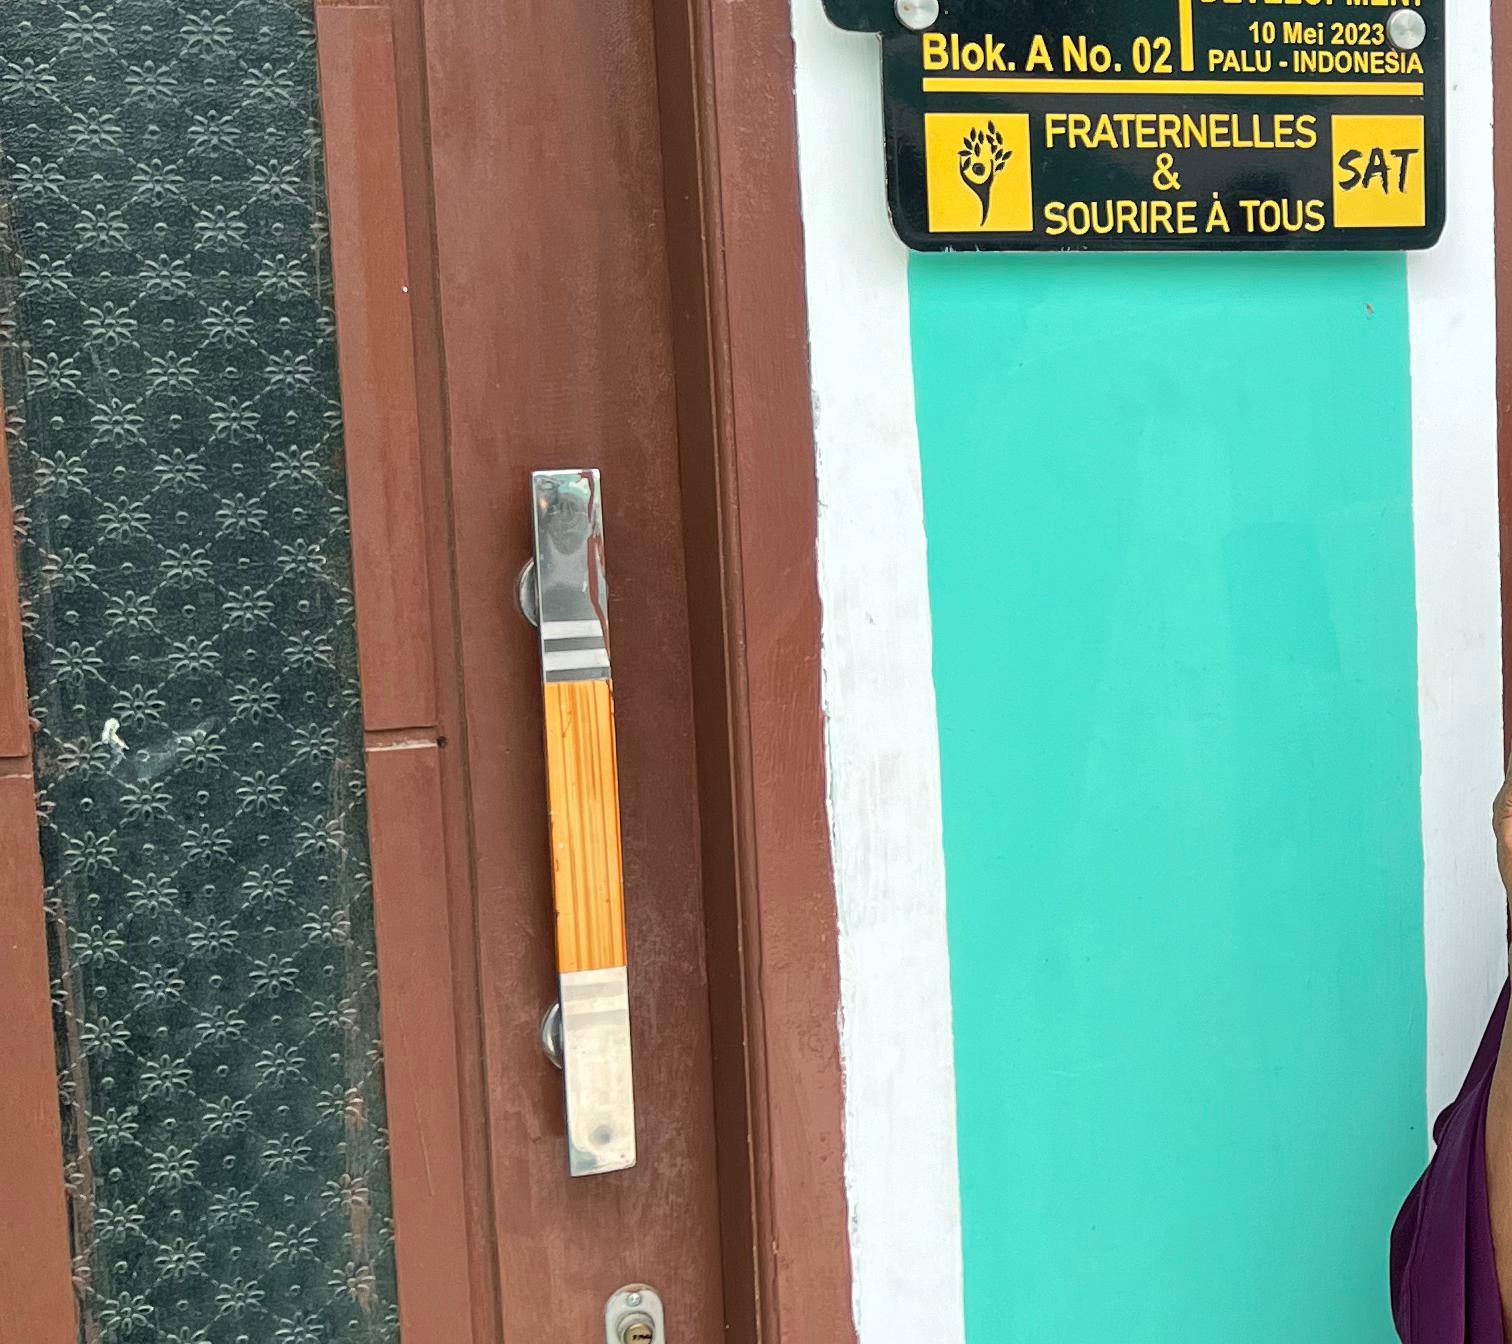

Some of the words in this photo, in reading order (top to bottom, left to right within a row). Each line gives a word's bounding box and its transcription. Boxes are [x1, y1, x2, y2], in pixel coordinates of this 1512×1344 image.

[921, 31, 1016, 72] Blok.
[1025, 34, 1054, 72] A
[1062, 35, 1122, 73] No.
[1131, 35, 1173, 74] 02
[1248, 21, 1276, 45] 10
[1282, 21, 1324, 46] Mei
[1330, 22, 1386, 46] 2023
[1208, 49, 1272, 73] PALU
[1292, 49, 1424, 74] INDONESIA
[1044, 113, 1318, 149] FRATERNELLES
[1152, 152, 1182, 191] &
[1338, 147, 1419, 195] SAT
[1043, 199, 1198, 236] SOURIRE
[1238, 198, 1326, 233] TOUS
